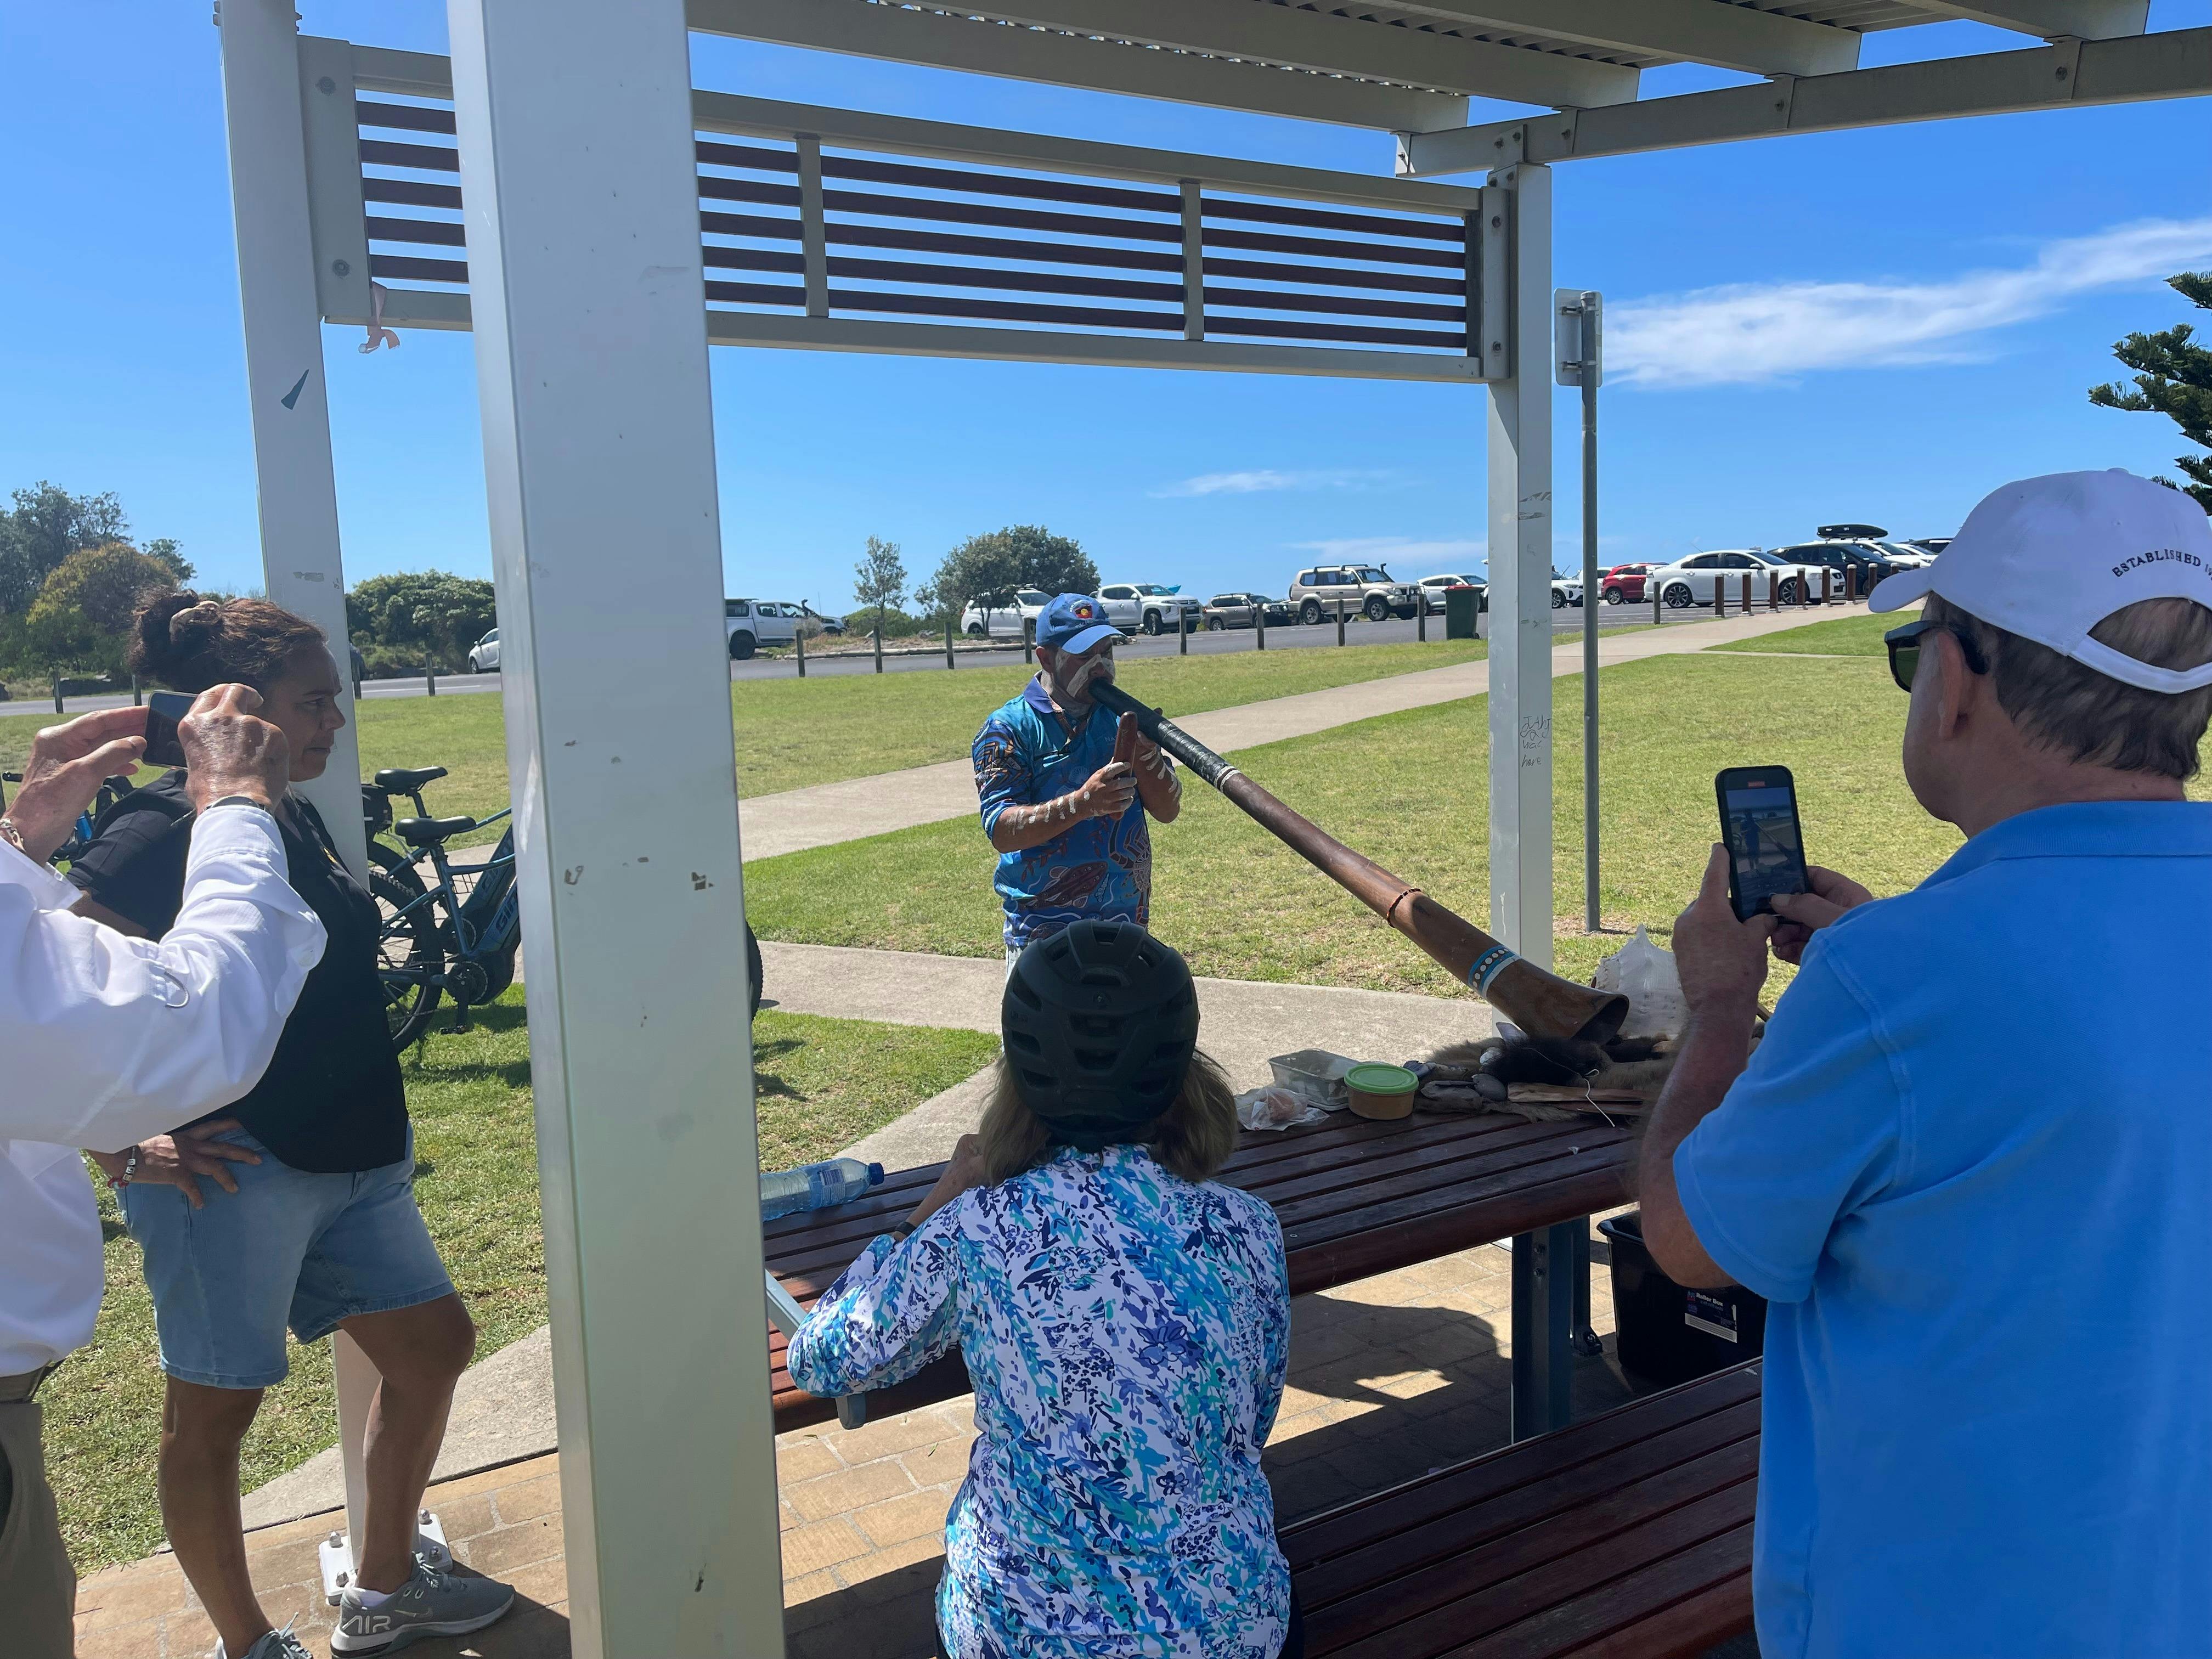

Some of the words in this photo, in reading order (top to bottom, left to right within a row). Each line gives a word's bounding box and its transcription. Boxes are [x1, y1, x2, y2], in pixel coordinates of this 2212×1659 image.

[2112, 549, 2201, 577] ESTABLISHED
[1521, 754, 1542, 768] here
[342, 1615, 391, 1634] AIR
